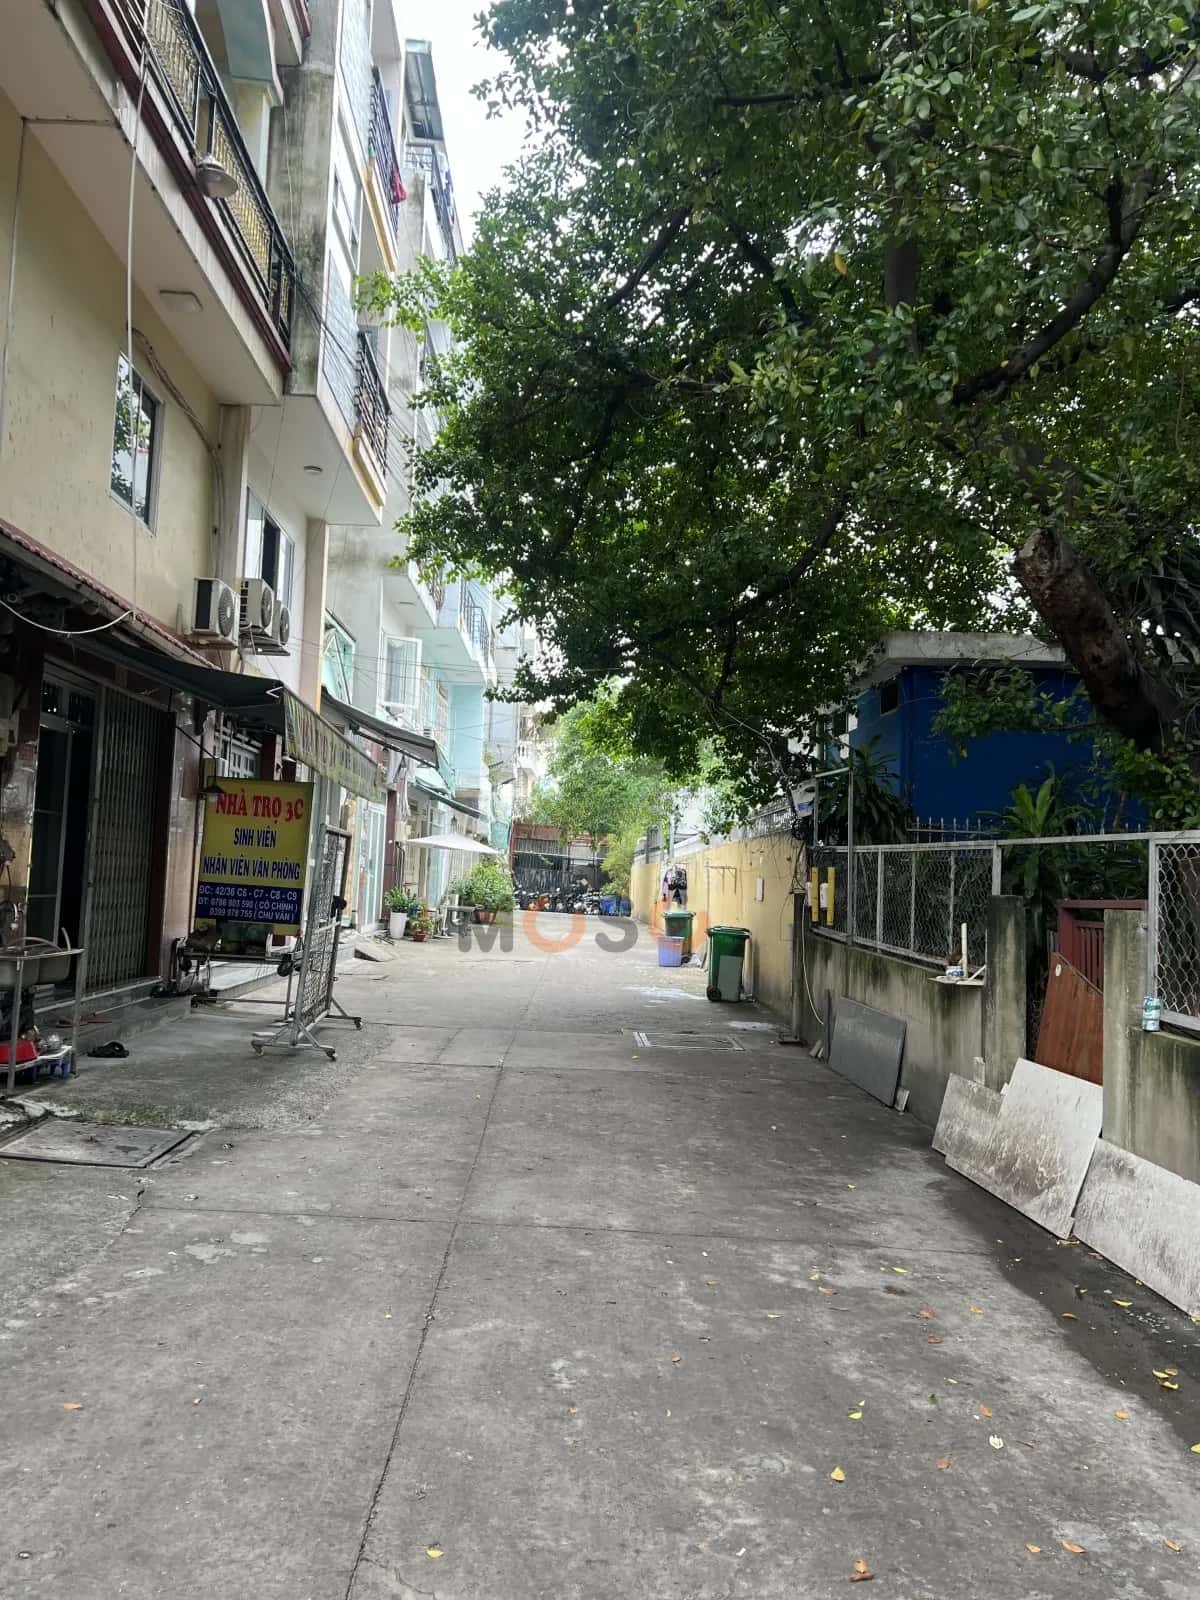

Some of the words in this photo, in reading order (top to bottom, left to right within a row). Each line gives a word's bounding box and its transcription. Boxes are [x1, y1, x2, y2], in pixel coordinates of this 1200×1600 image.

[216, 788, 248, 816] NHÀ
[252, 795, 281, 824] TRỌ
[285, 798, 304, 822] 3C
[234, 827, 255, 846] SINH
[257, 826, 277, 848] VIÊN
[230, 854, 250, 876] VIÊN
[271, 857, 301, 880] PHÒNG
[237, 888, 247, 897] C6
[254, 888, 264, 898] C7
[287, 891, 297, 901] C9
[259, 899, 270, 910] CÔ
